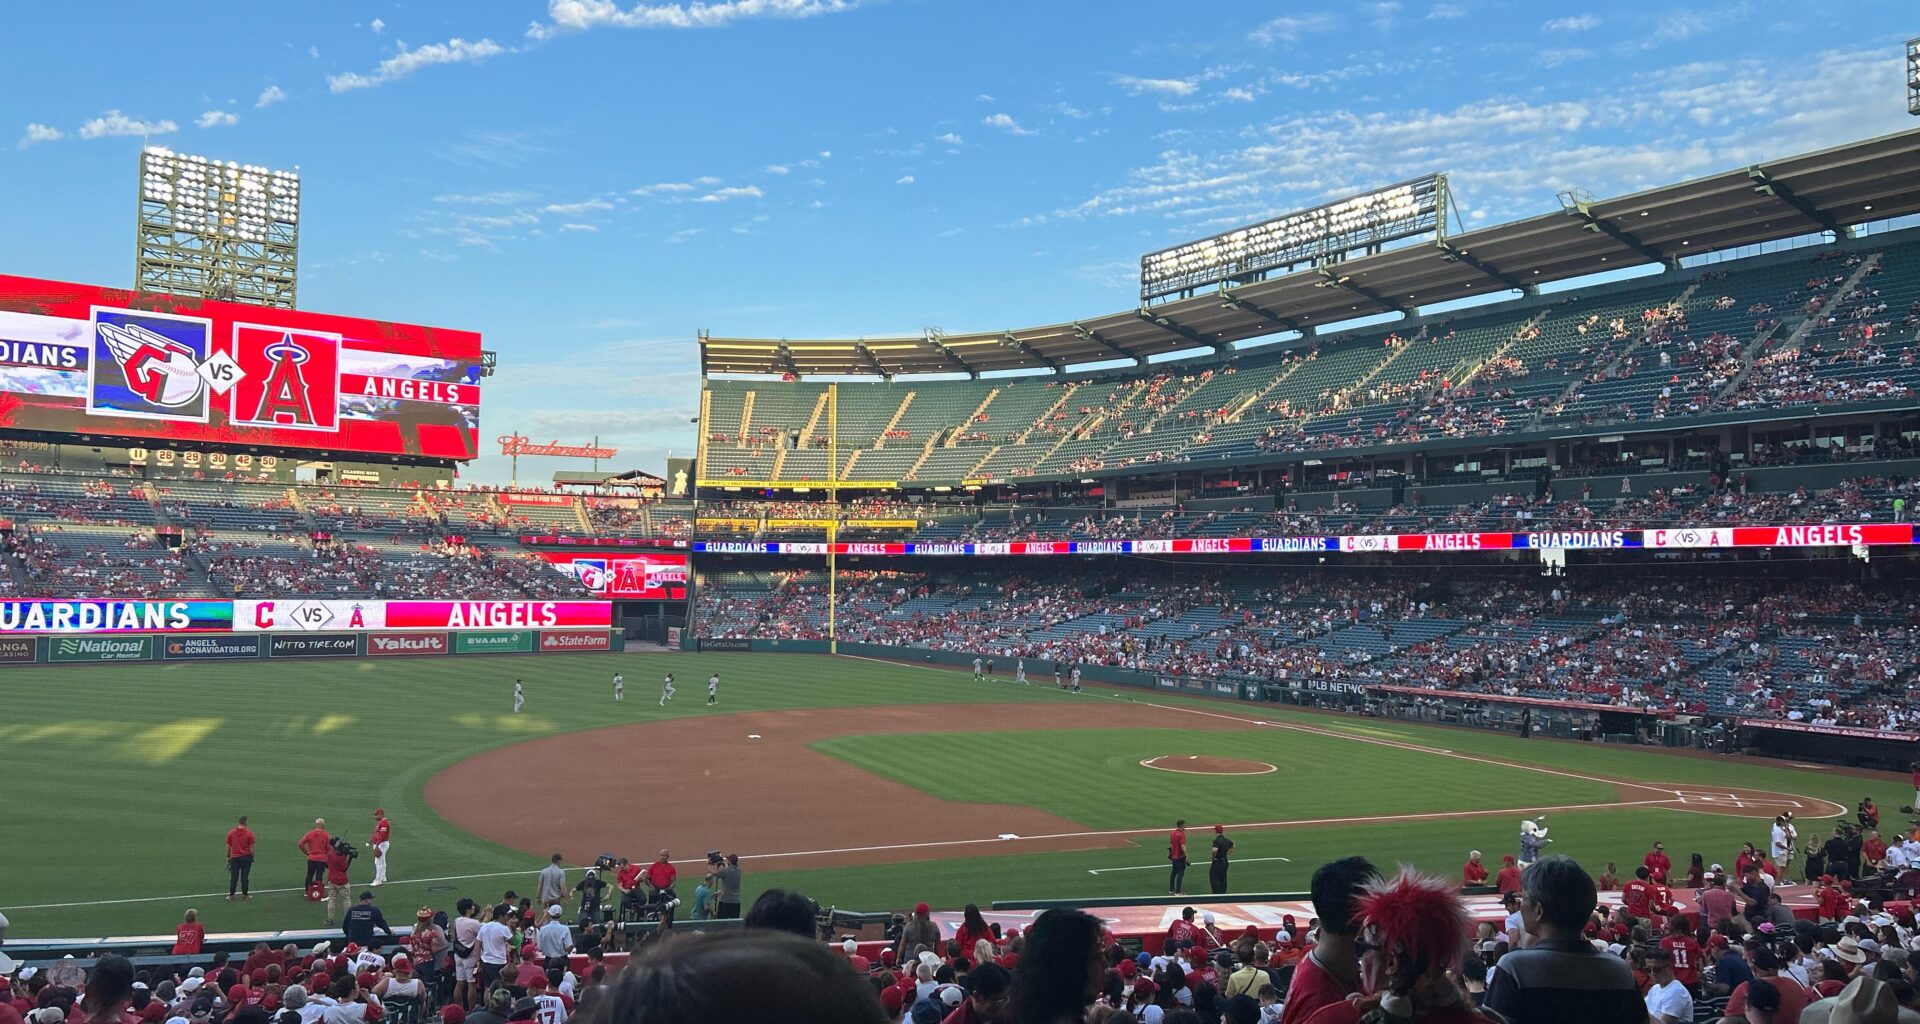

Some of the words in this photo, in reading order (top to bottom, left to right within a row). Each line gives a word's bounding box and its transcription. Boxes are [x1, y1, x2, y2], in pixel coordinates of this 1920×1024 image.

[209, 362, 233, 381] VS
[363, 376, 459, 403] ANGELS
[134, 449, 143, 457] 11
[159, 450, 172, 459] 26
[186, 452, 199, 461] 29
[212, 453, 225, 462] 30
[237, 455, 250, 464] 42
[262, 456, 275, 465] 50
[1528, 531, 1624, 549] GUARDIANS
[1655, 530, 1666, 546] C
[1681, 532, 1694, 544] VS
[1710, 529, 1719, 546] A
[1776, 525, 1863, 546] ANGELS
[1137, 541, 1143, 551] C
[1191, 539, 1230, 552] ANGELS
[1262, 538, 1326, 551] GUARDIANS
[1347, 536, 1354, 549] C
[1364, 539, 1373, 547] VS
[1383, 537, 1390, 549] A
[1425, 534, 1481, 549] ANGELS
[705, 543, 767, 552] GUARDIANS
[785, 544, 791, 552] C
[847, 544, 886, 553] ANGELS
[914, 543, 965, 553] GUARDIANS
[1025, 543, 1054, 553] ANGELS
[1077, 542, 1122, 552] GUARDIANS
[650, 573, 682, 581] ANGELS
[255, 601, 275, 629] C
[303, 608, 322, 623] VS
[349, 603, 364, 628] A
[447, 603, 557, 627] ANGELS
[78, 639, 145, 652] National
[273, 641, 306, 650] NITTO
[373, 637, 443, 650] Yakult
[700, 640, 749, 648] HeGetsUs.com
[184, 645, 257, 654] OCNAVIGATOR.ORG
[1308, 680, 1328, 691] MLB
[1673, 948, 1689, 968] 11
